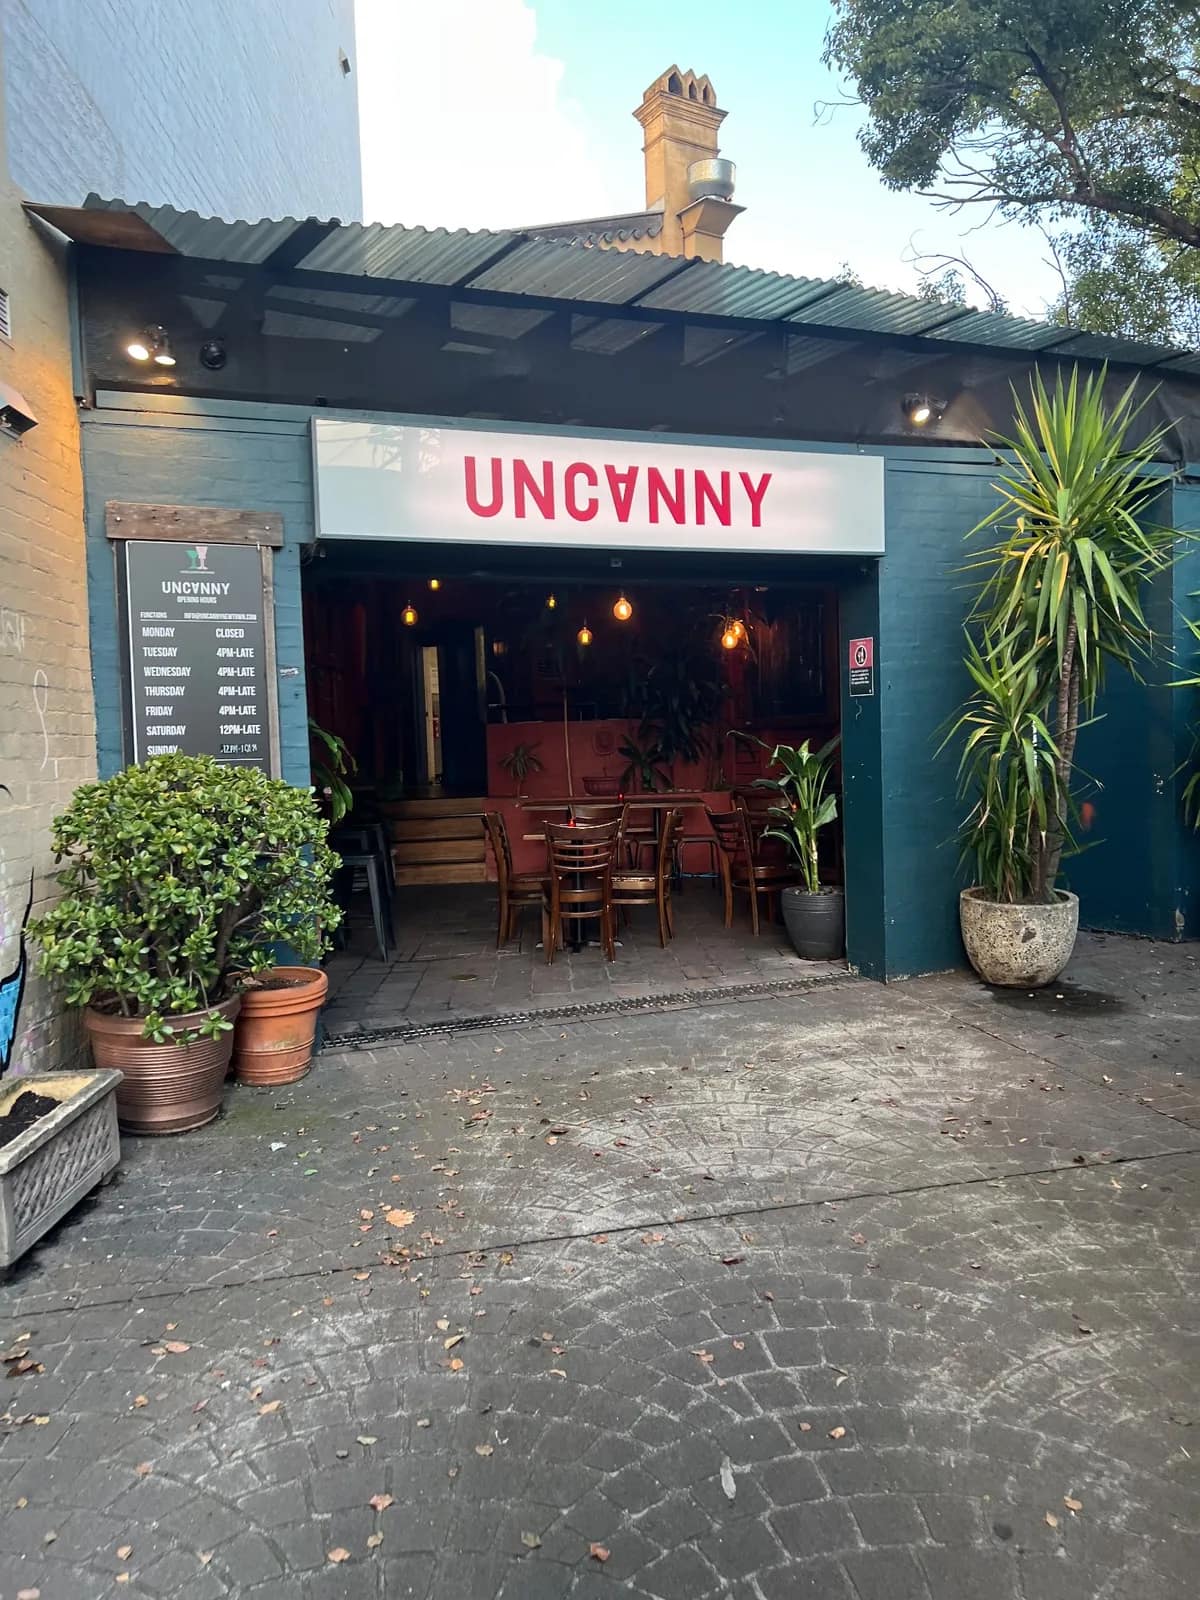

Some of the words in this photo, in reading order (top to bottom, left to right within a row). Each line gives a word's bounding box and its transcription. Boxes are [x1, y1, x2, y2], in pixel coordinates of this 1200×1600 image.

[464, 456, 772, 527] UNCANNY
[162, 581, 230, 595] UNCANNY
[142, 627, 175, 637] MONDAY
[216, 628, 244, 638] CLOSED
[143, 647, 177, 657] TUESDAY
[216, 648, 254, 658] 4PM-LATE
[144, 667, 191, 677] WEDNESDAY
[217, 667, 255, 676] 4PM-LATE
[145, 687, 185, 696] THURSDAY
[218, 686, 256, 696] 4PM-LATE
[146, 706, 173, 716] FRIDAY
[219, 705, 257, 715] 4PM-LATE
[146, 726, 185, 736] SATURDAY
[220, 725, 261, 735] 12PM-LATE
[147, 745, 178, 755] SUNDAY
